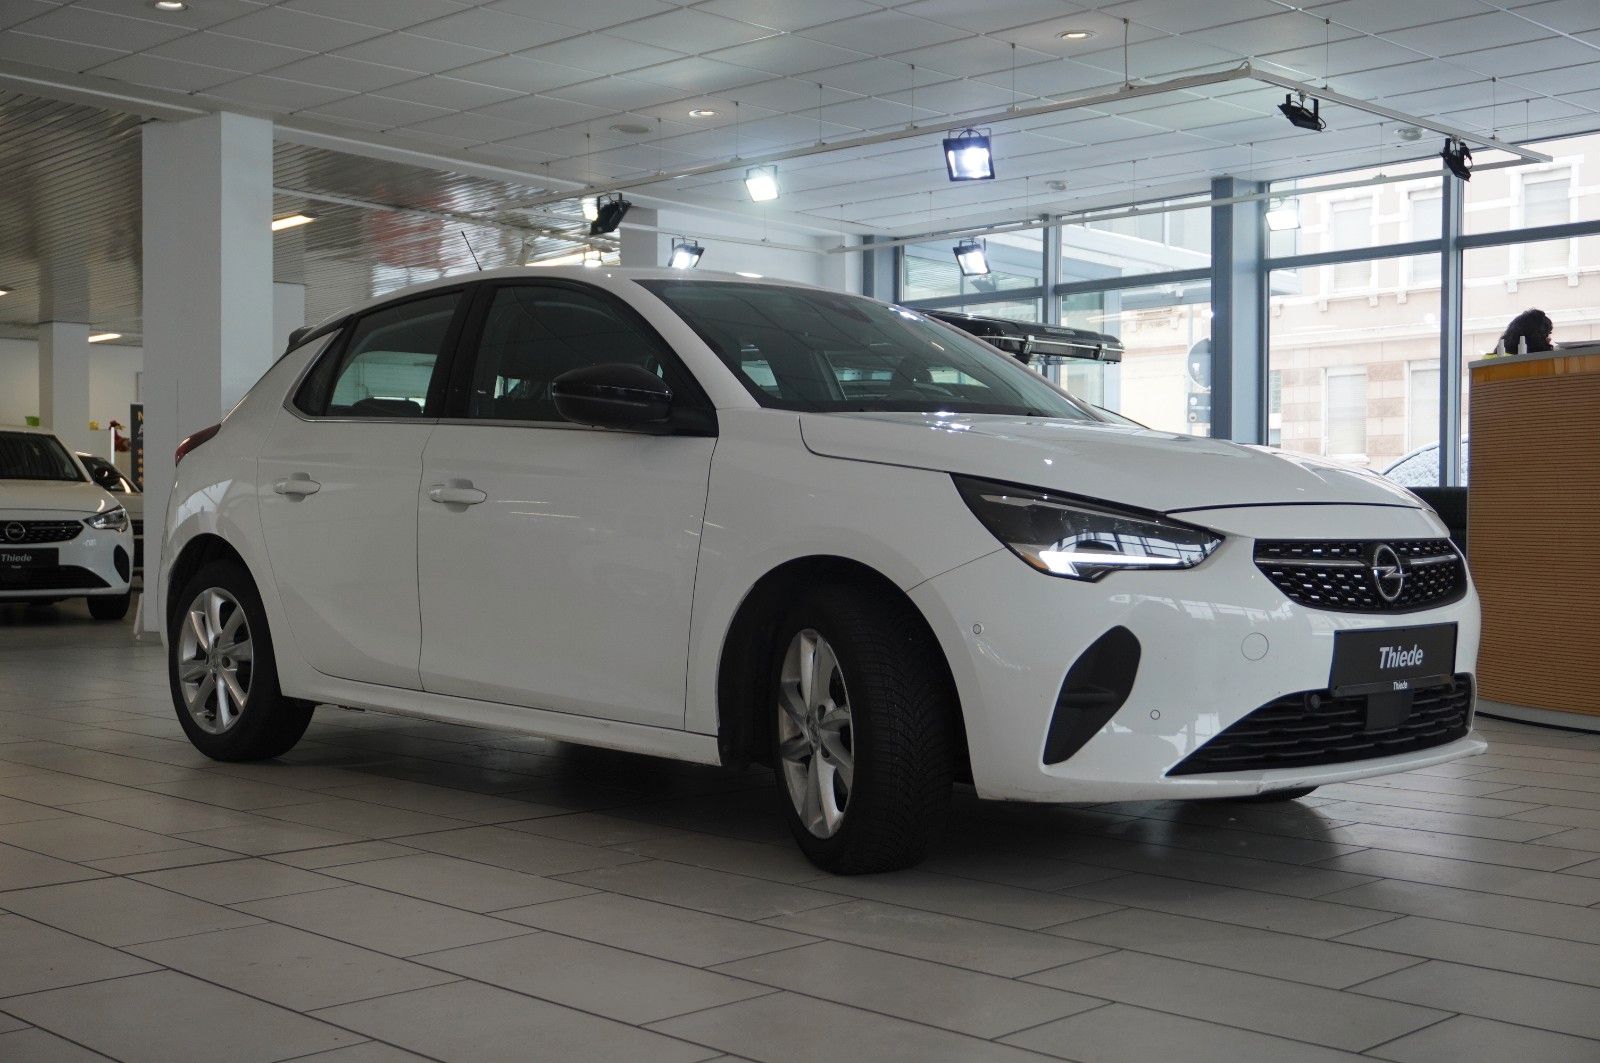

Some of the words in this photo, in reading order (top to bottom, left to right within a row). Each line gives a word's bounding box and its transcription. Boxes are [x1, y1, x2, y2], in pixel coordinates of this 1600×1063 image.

[1, 553, 32, 562] Thiede
[1379, 644, 1424, 669] Thiede
[1393, 680, 1408, 691] Thiede
